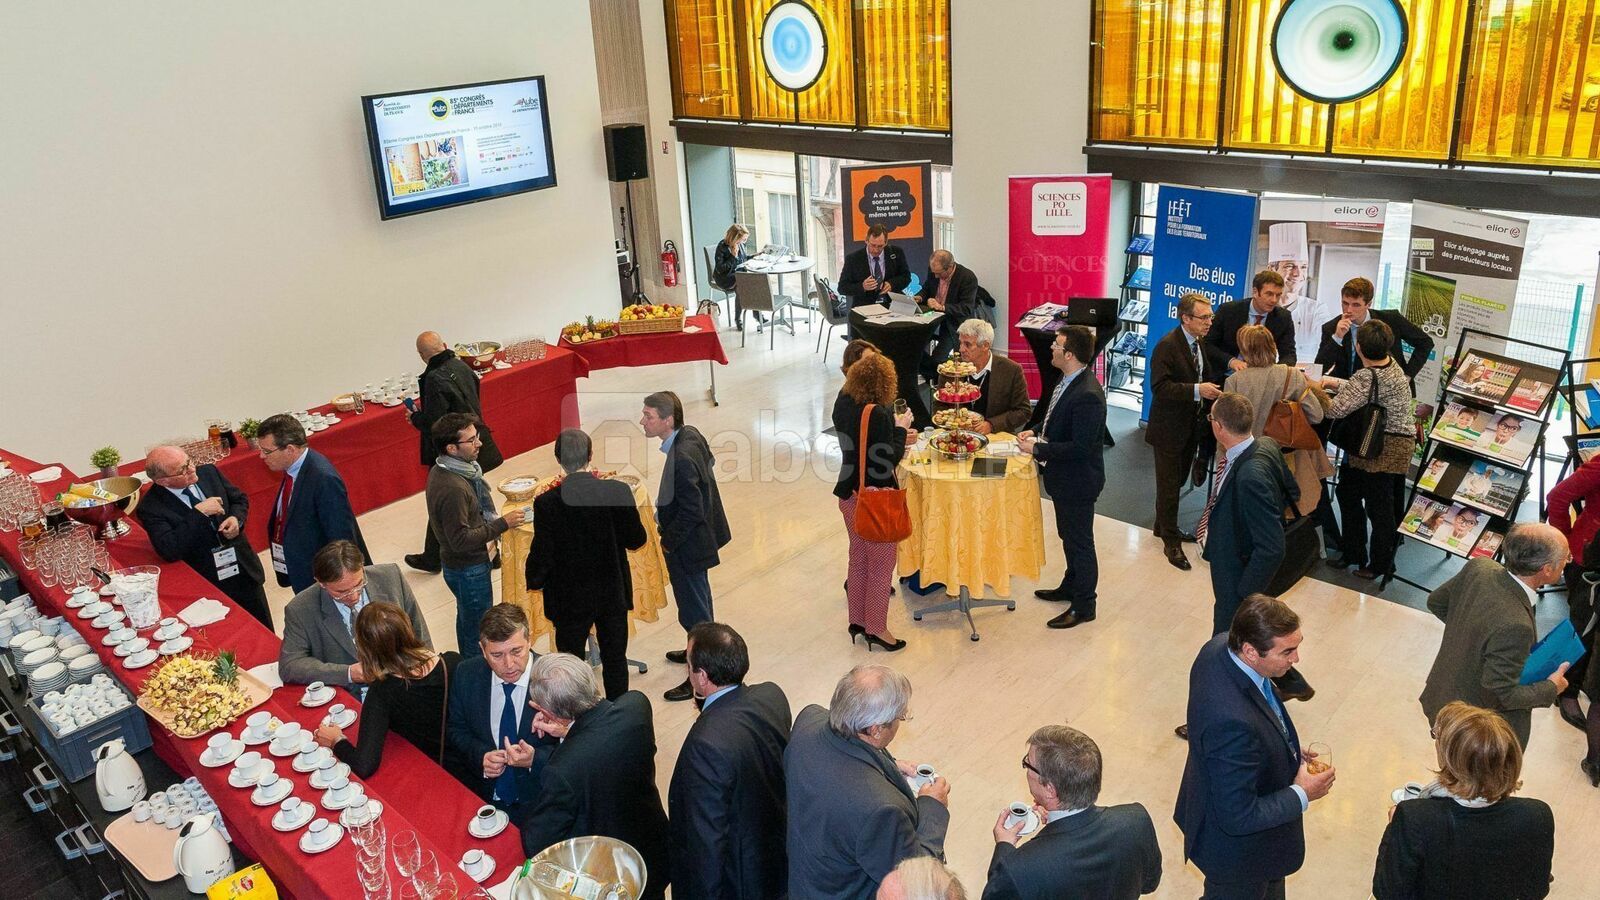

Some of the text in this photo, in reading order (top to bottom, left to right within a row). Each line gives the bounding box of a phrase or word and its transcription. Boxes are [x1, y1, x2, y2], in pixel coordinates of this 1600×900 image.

[1038, 193, 1081, 201] SCIENCES
[1334, 206, 1363, 214] elior
[1486, 224, 1509, 233] elior
[1443, 240, 1457, 250] Elior
[1458, 244, 1486, 257] s'engage
[1487, 250, 1510, 262] auprès
[1010, 256, 1108, 272] SCIENCES
[1441, 250, 1513, 273] des producteurs locaux
[1043, 274, 1073, 291] PO
[1190, 262, 1235, 286] Des élus
[1026, 292, 1085, 308] LILL
[1164, 283, 1176, 297] au
[1219, 290, 1233, 305] de
[1168, 302, 1178, 319] la
